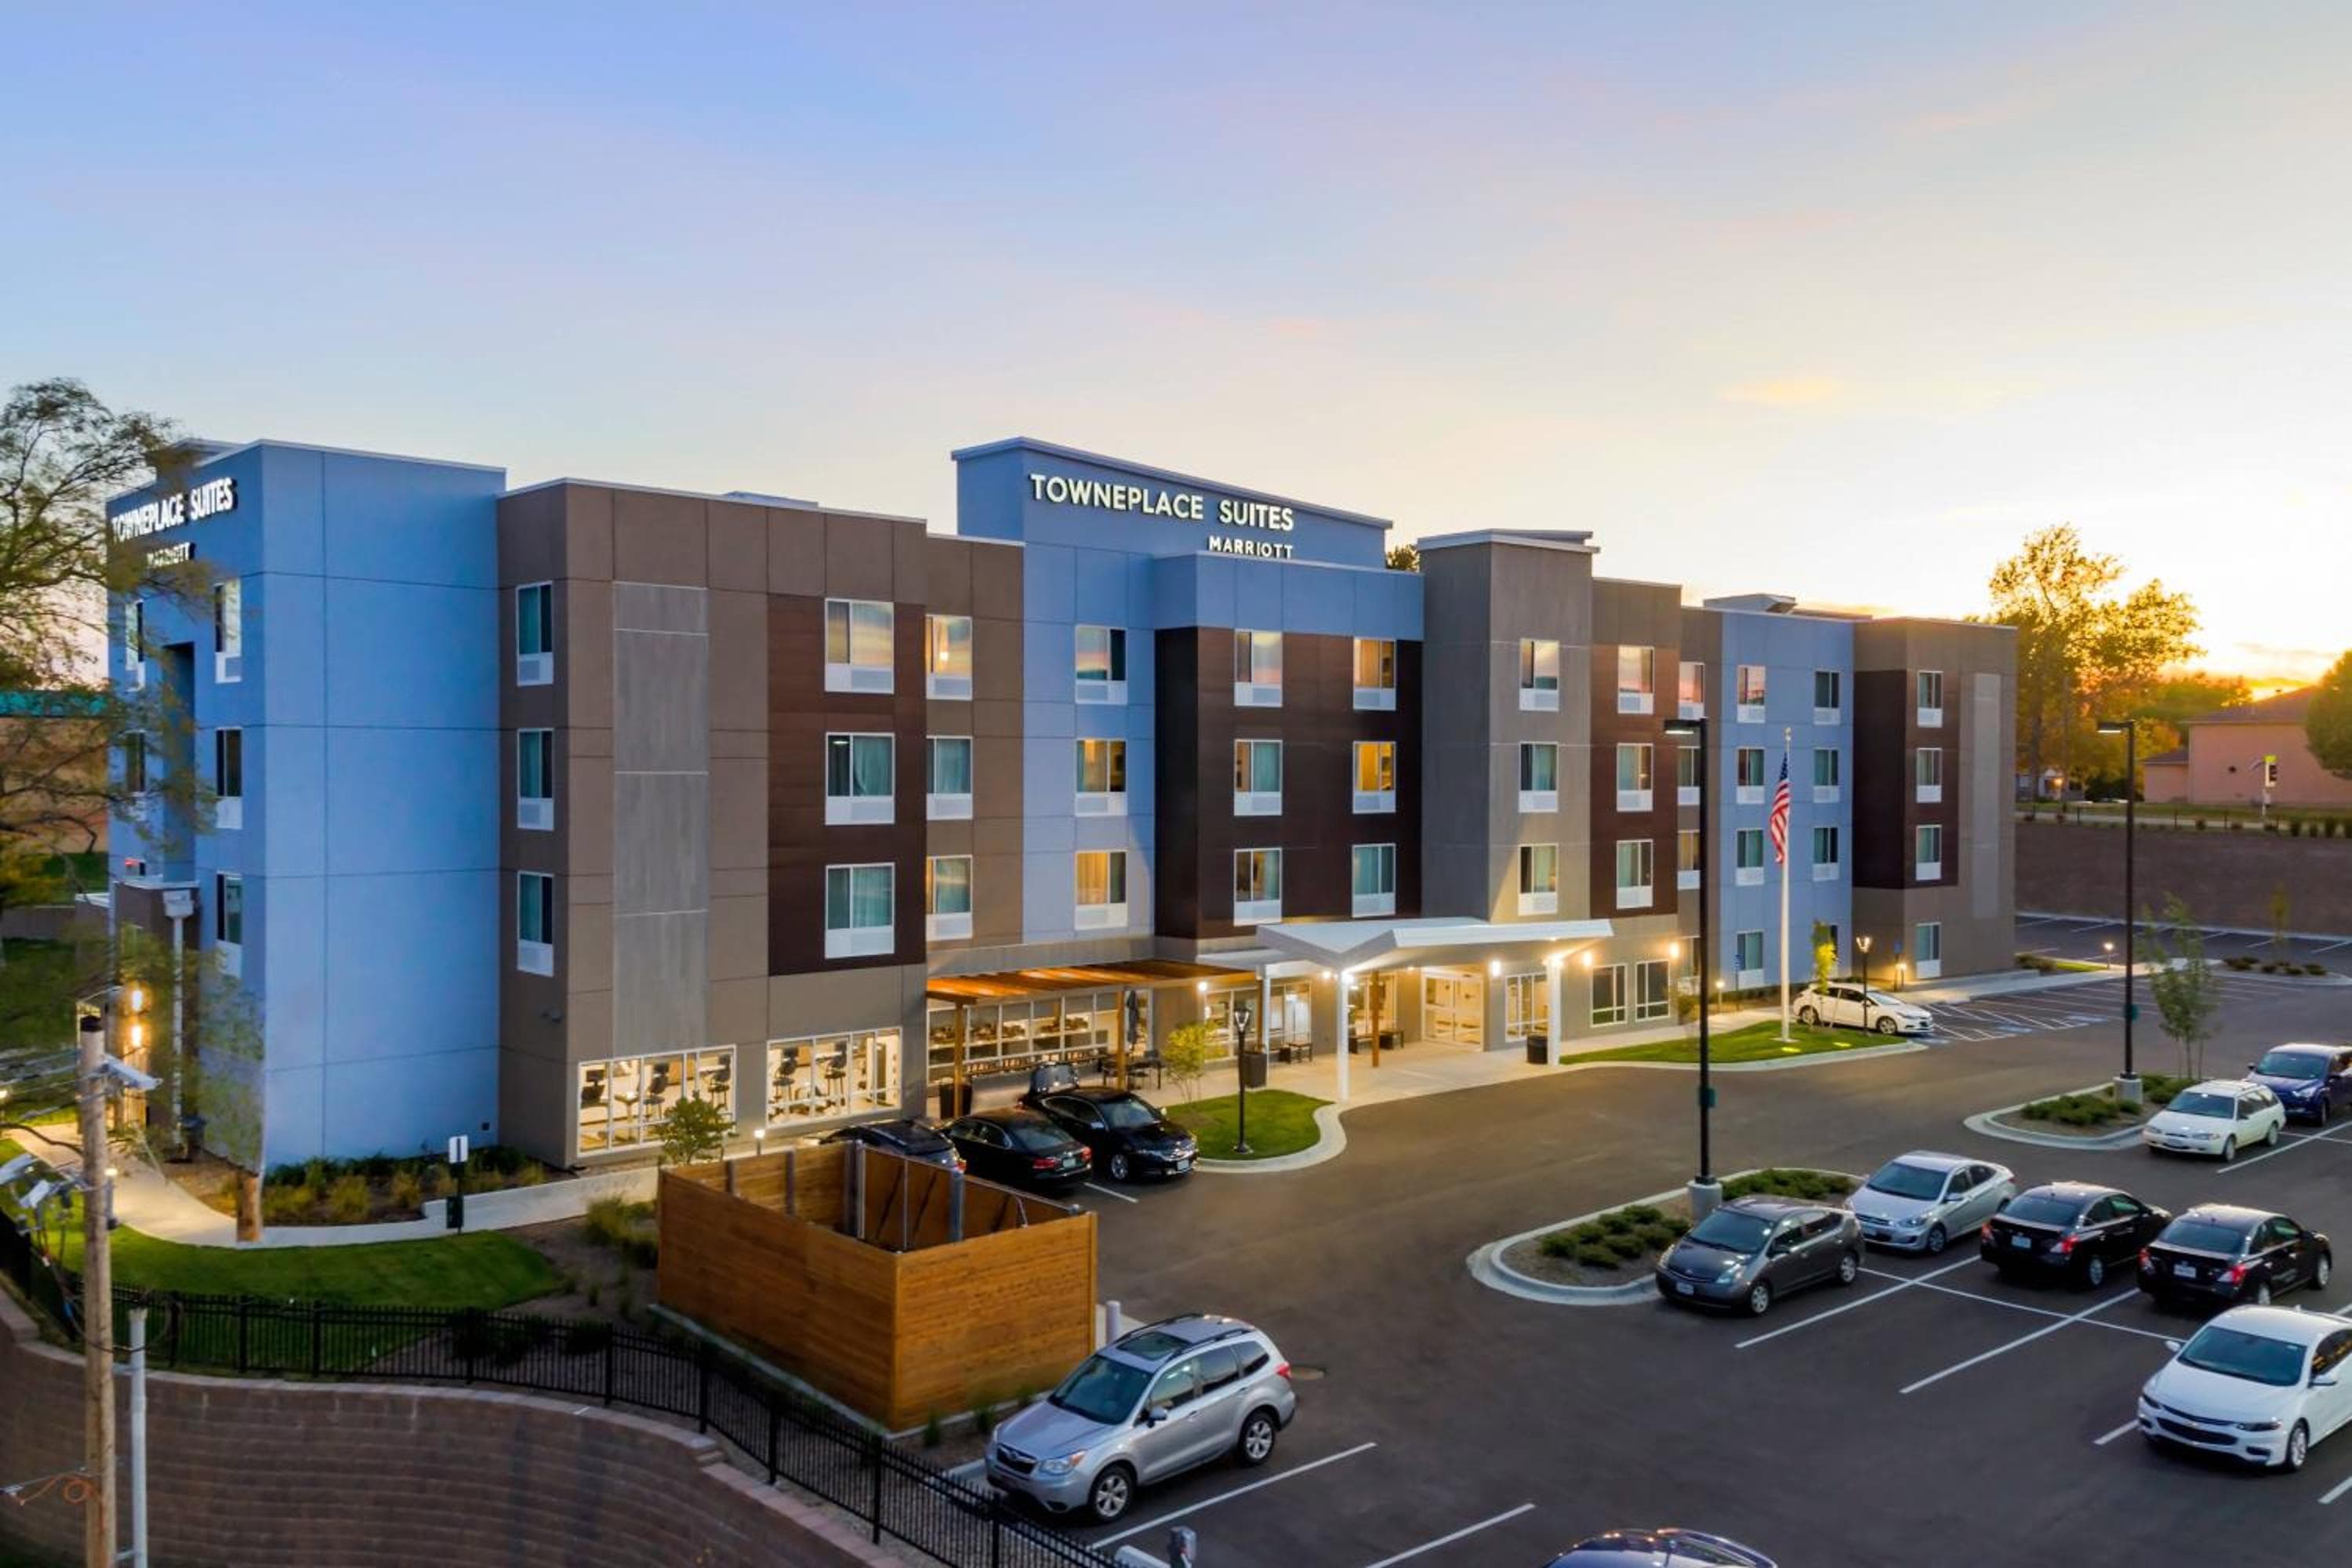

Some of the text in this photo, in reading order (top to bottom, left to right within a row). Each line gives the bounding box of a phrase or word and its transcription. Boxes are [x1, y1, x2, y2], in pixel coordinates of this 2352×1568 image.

[111, 477, 233, 543] TOWNEPLACE SUITES
[1030, 474, 1294, 532] TOWNEPLACE SUITES
[1208, 535, 1293, 559] MARRIOTT
